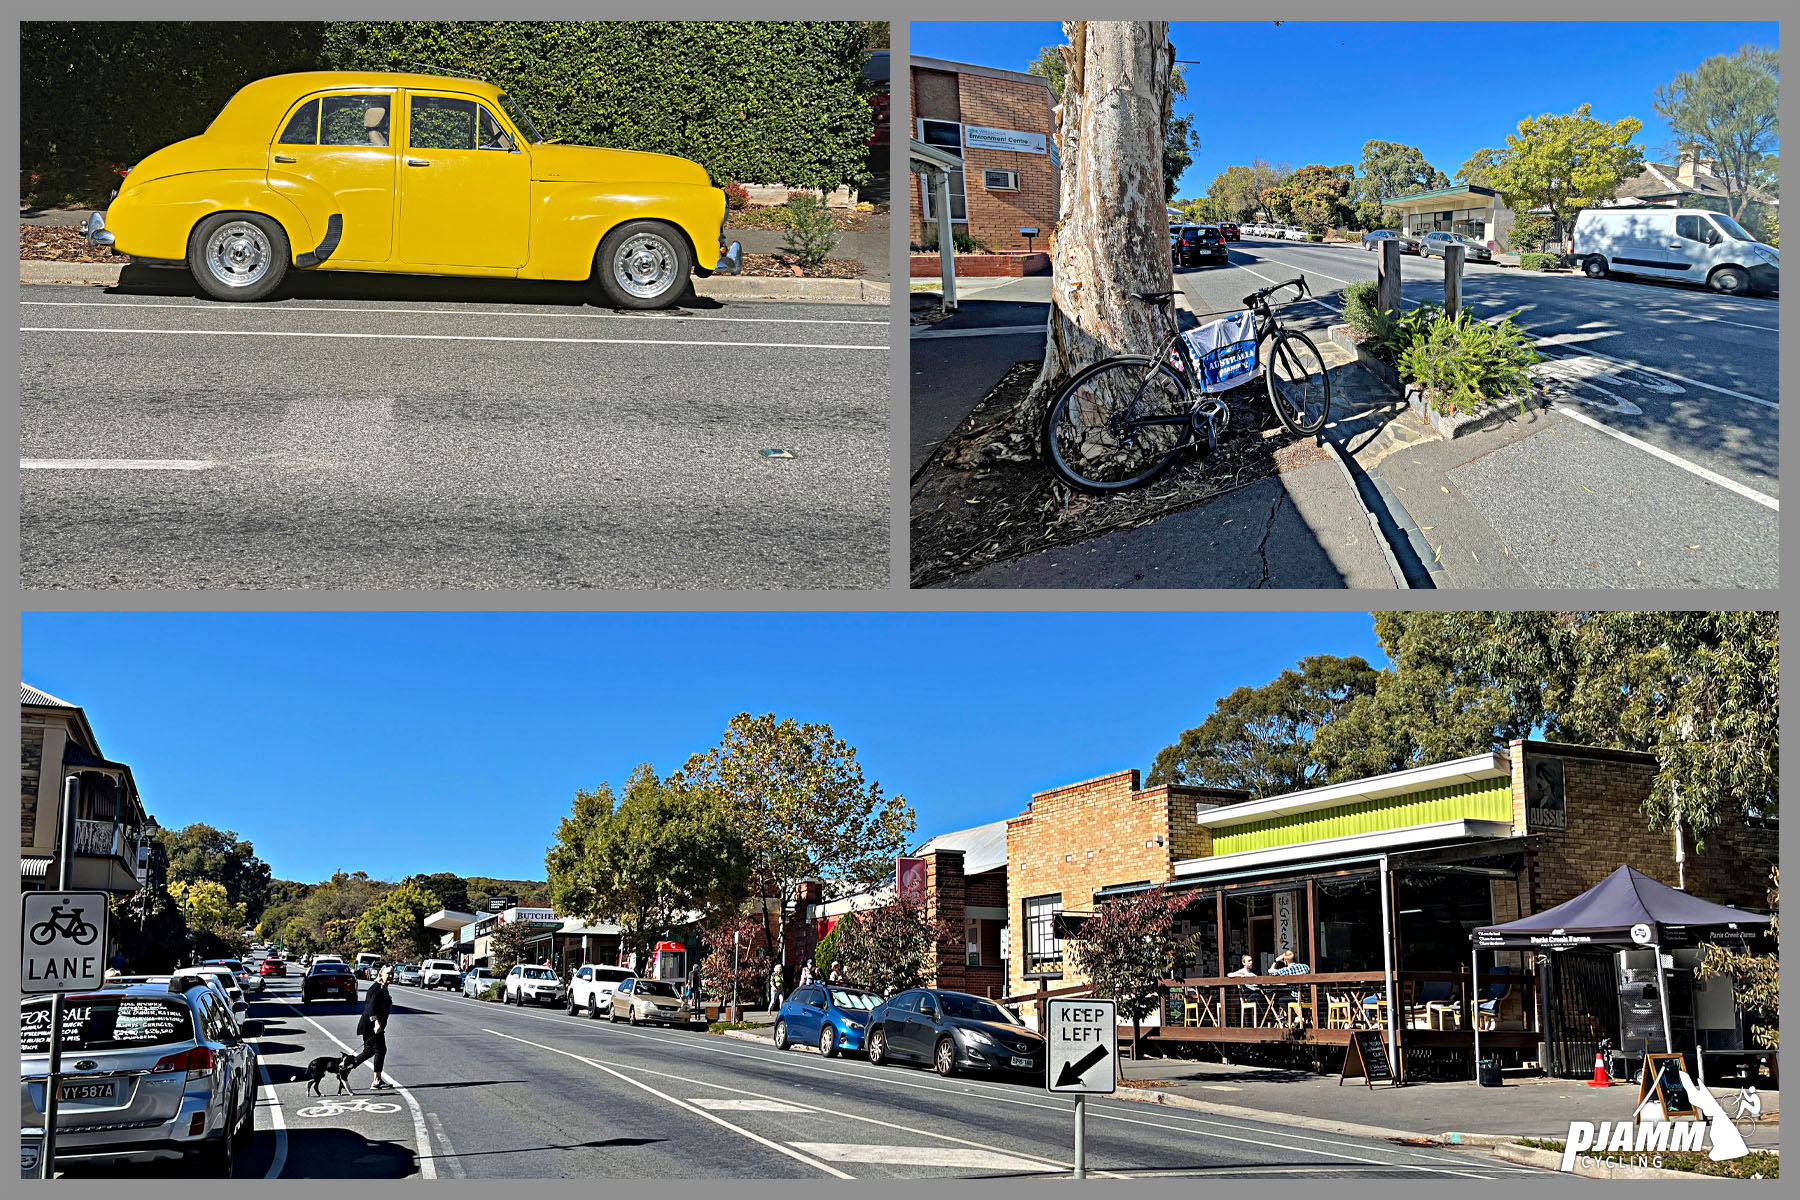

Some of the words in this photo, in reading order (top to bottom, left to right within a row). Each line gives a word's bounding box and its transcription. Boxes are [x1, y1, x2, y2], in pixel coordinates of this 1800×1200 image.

[969, 133, 1007, 142] Environment
[1008, 137, 1028, 145] Centre
[1208, 349, 1254, 370] AUSTRALIA
[1530, 807, 1565, 828] AUSSIE
[28, 957, 95, 980] LANE
[21, 1010, 51, 1025] FOR
[62, 1006, 92, 1021] SALE
[1061, 1008, 1105, 1022] KEEP
[1062, 1028, 1103, 1042] LEFT
